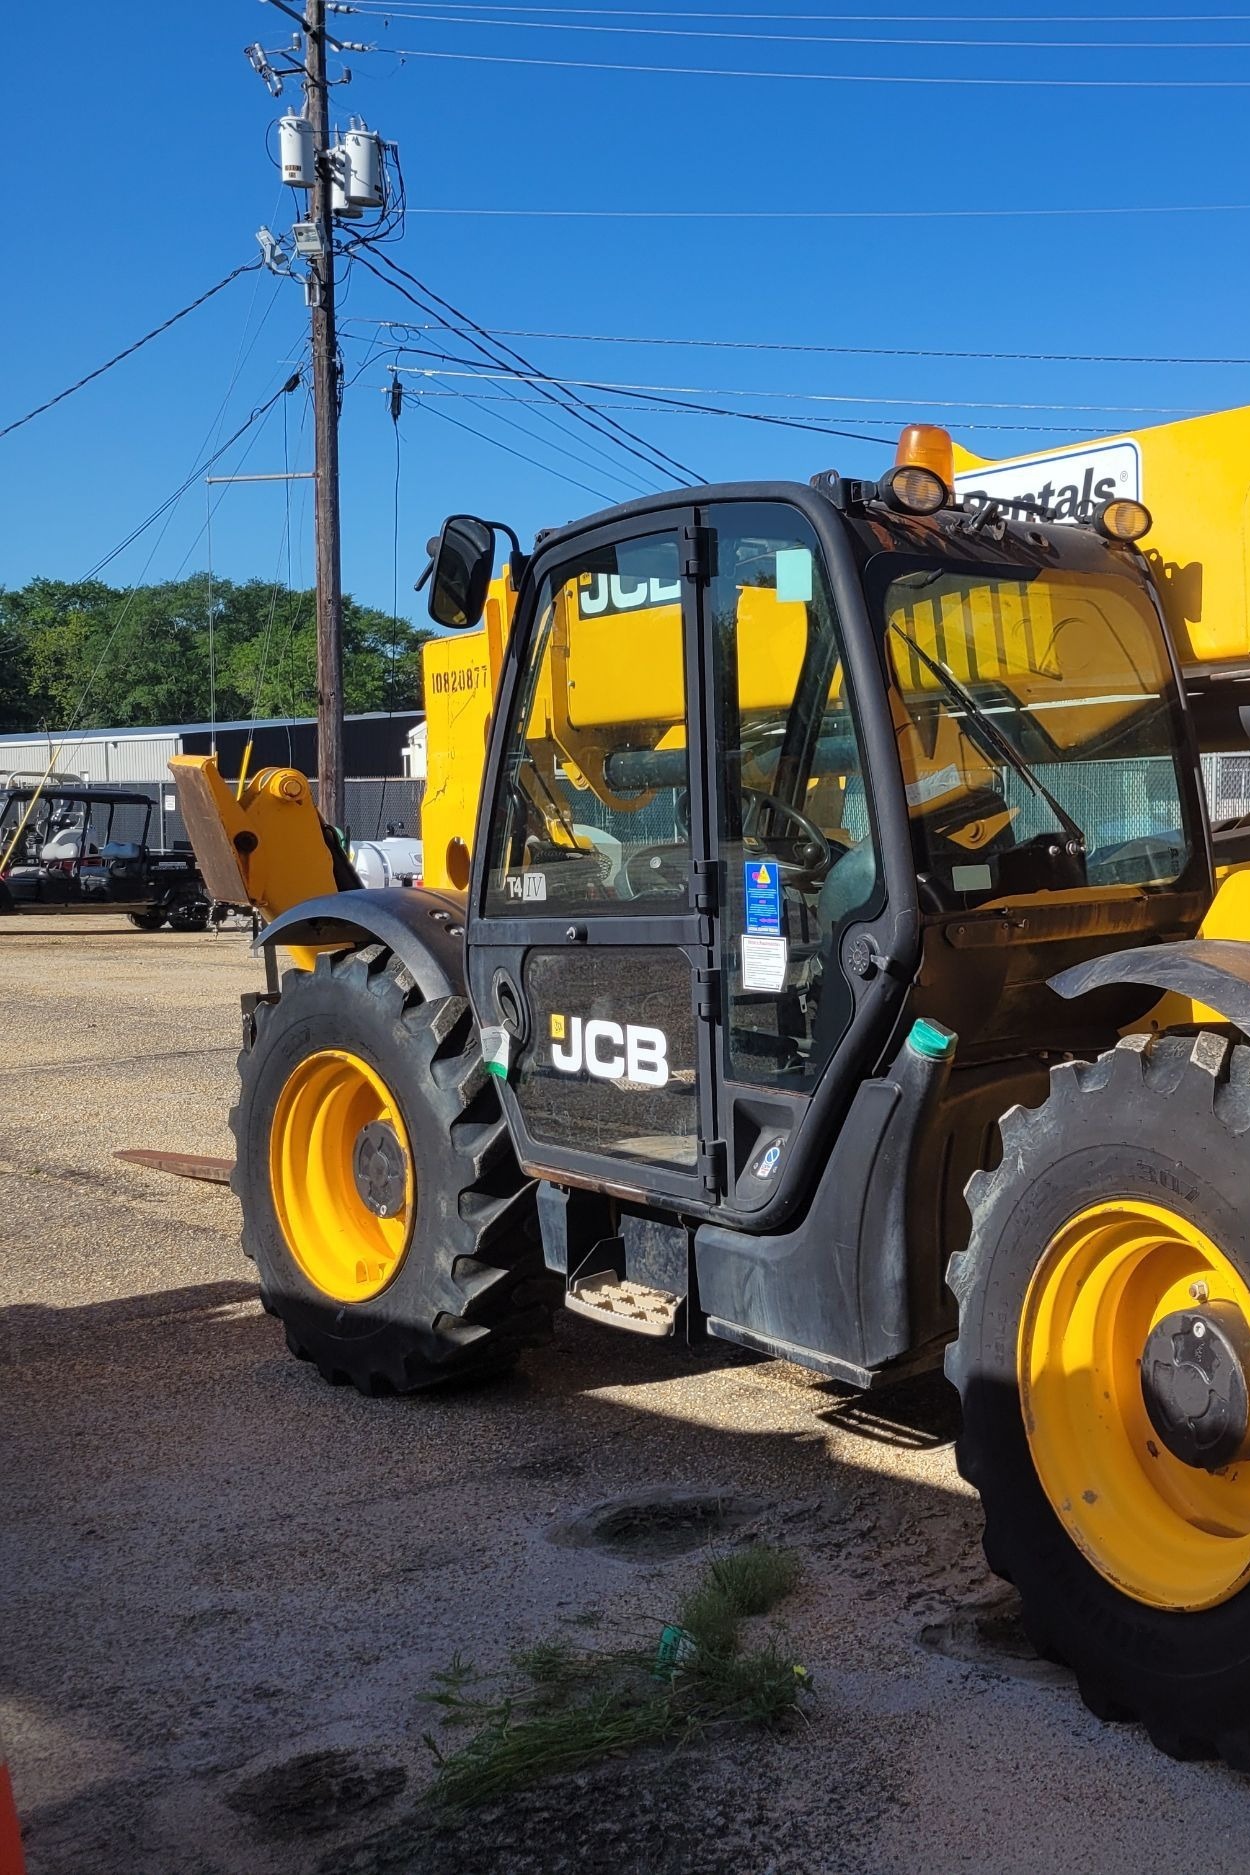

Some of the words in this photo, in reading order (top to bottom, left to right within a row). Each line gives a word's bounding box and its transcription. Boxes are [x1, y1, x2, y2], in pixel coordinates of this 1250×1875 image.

[432, 665, 487, 694] 10820877
[527, 876, 543, 897] IV
[551, 1016, 669, 1086] JCB
